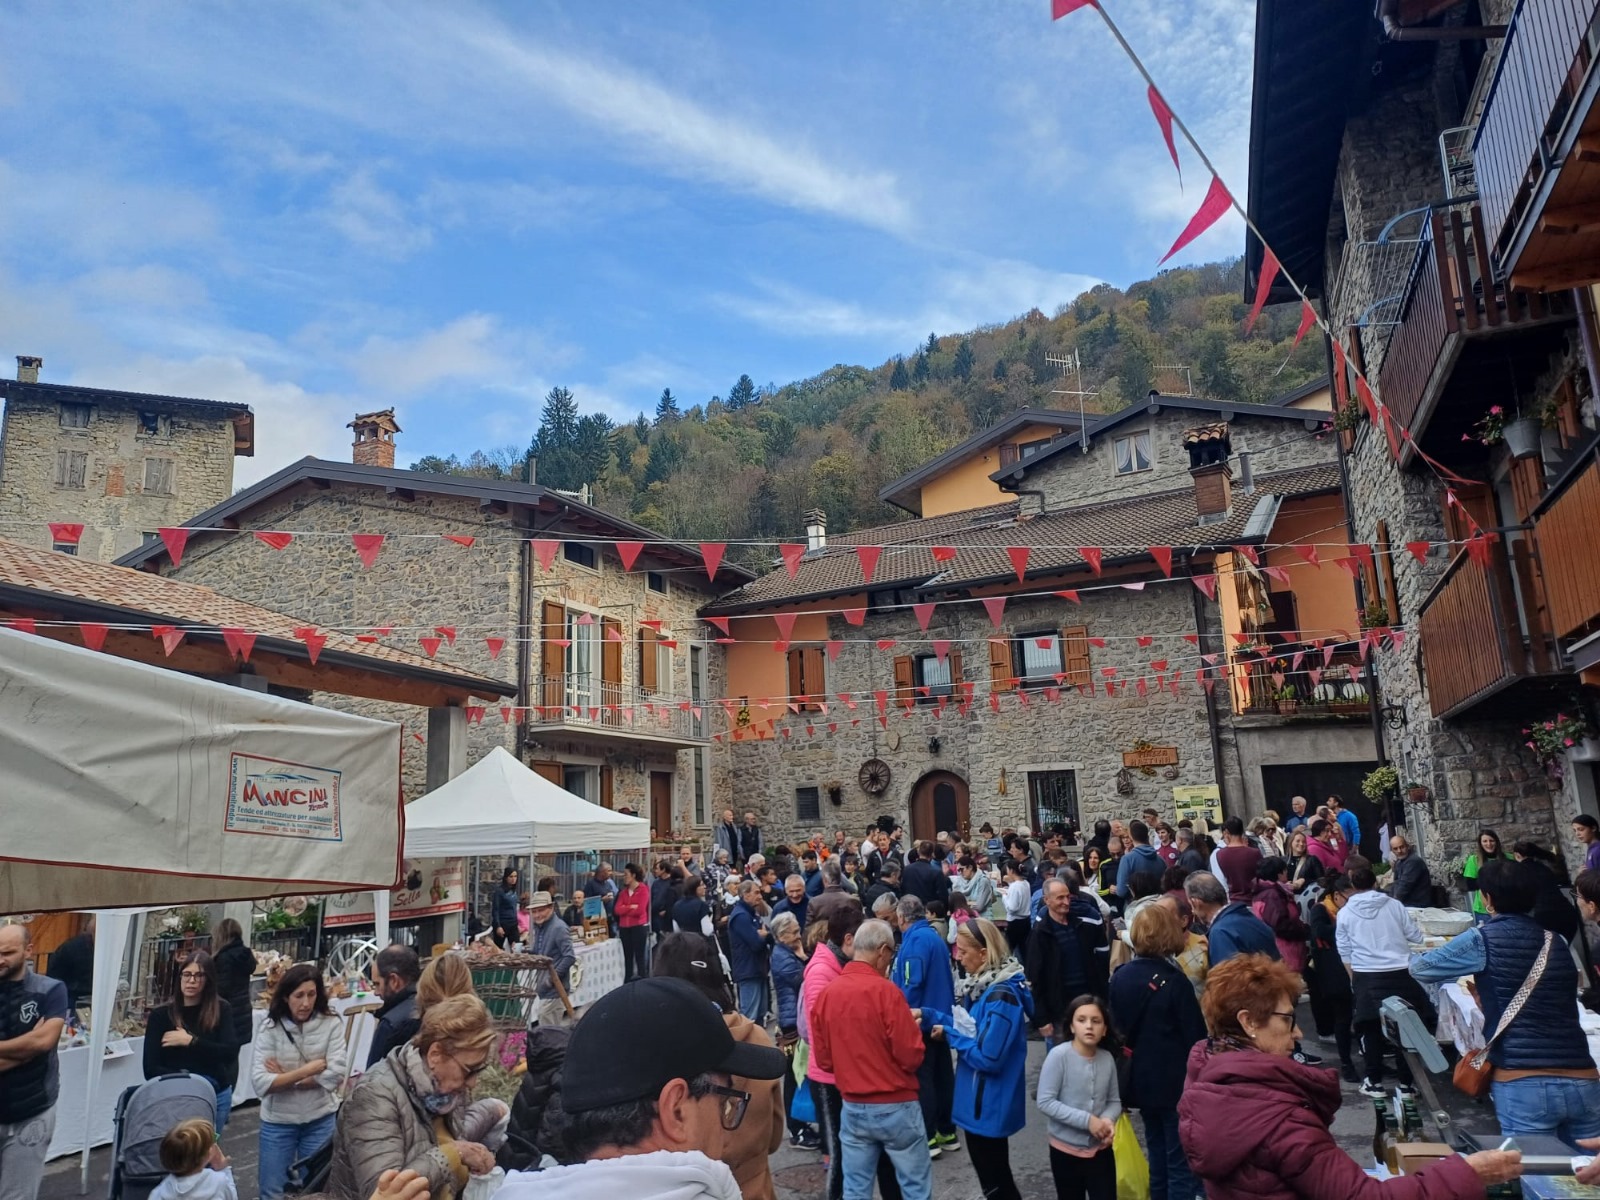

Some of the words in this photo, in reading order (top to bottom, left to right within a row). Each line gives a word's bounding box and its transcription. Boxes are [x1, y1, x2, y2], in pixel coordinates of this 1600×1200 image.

[242, 779, 328, 807] MANCINI
[237, 806, 255, 814] Tende
[393, 891, 421, 907] Sella
